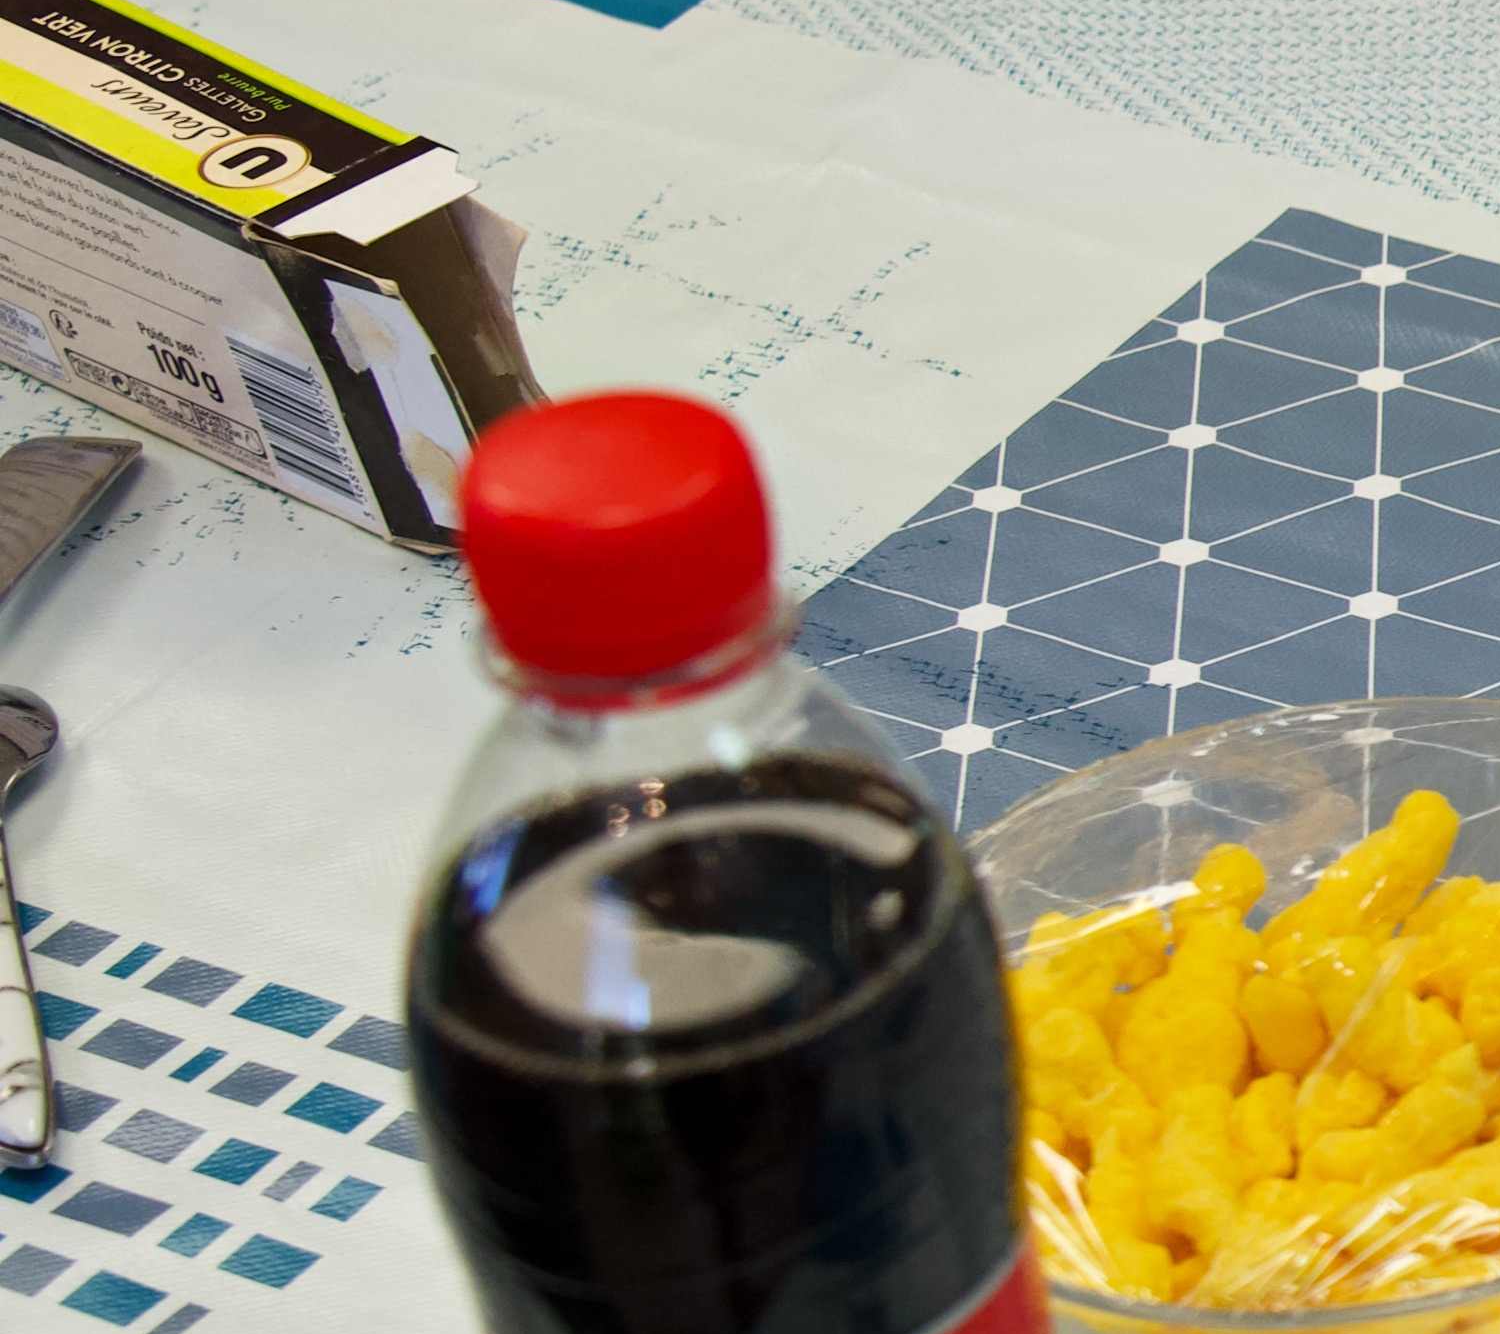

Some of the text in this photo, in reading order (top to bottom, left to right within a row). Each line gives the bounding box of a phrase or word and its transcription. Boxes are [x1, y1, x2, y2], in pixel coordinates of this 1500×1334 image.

[31, 10, 268, 123] GALETTES CITRON VERT
[216, 72, 294, 112] Pur beurre
[90, 79, 231, 141] Saveurs
[146, 344, 201, 388] 100
[200, 371, 225, 404] g
